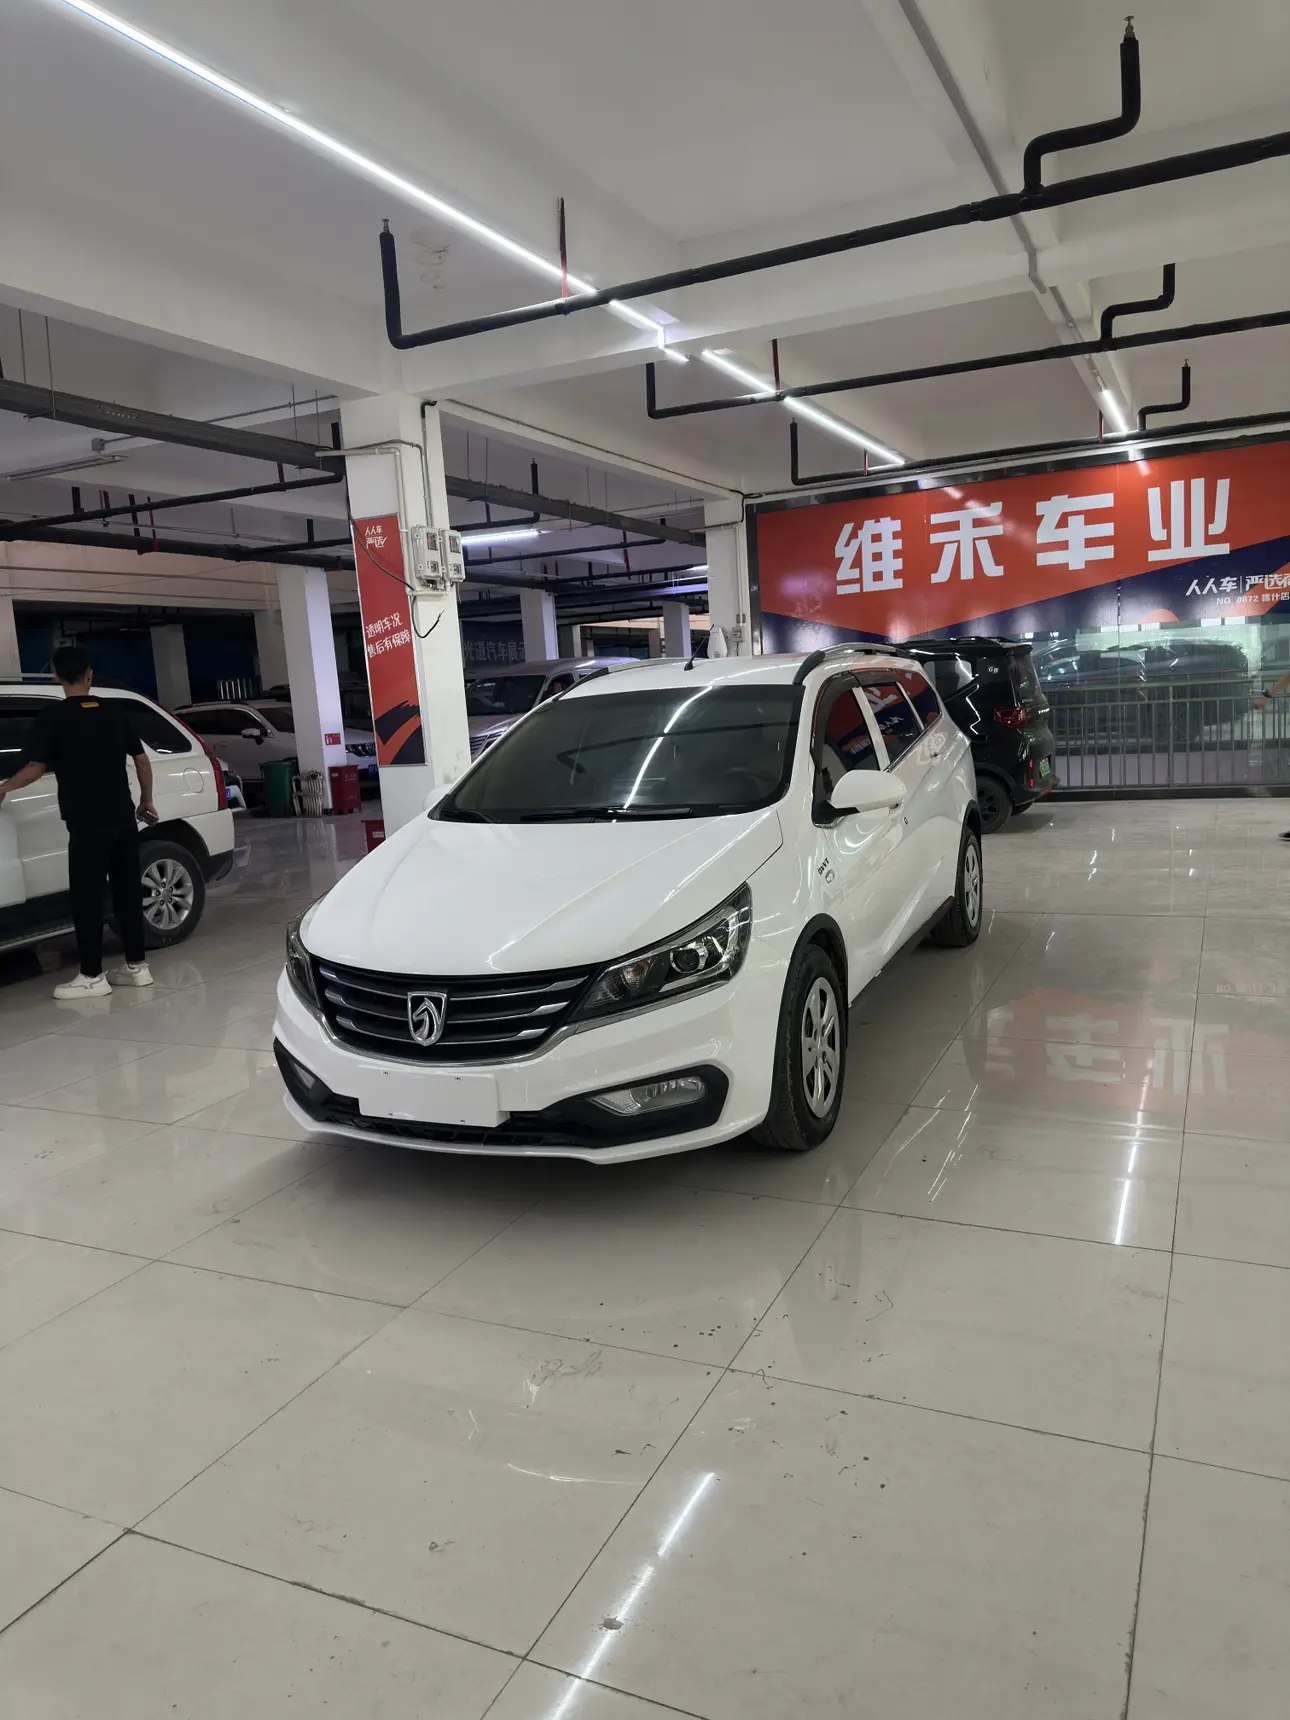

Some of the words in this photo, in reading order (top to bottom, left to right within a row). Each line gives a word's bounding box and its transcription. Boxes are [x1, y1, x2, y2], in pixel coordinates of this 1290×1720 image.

[365, 525, 383, 536] 人人车
[834, 478, 1230, 595] 维禾车业
[365, 536, 388, 549] 严选
[1185, 576, 1238, 596] 人人车
[365, 612, 404, 639] 透明车况
[367, 629, 412, 658] 售后有保障
